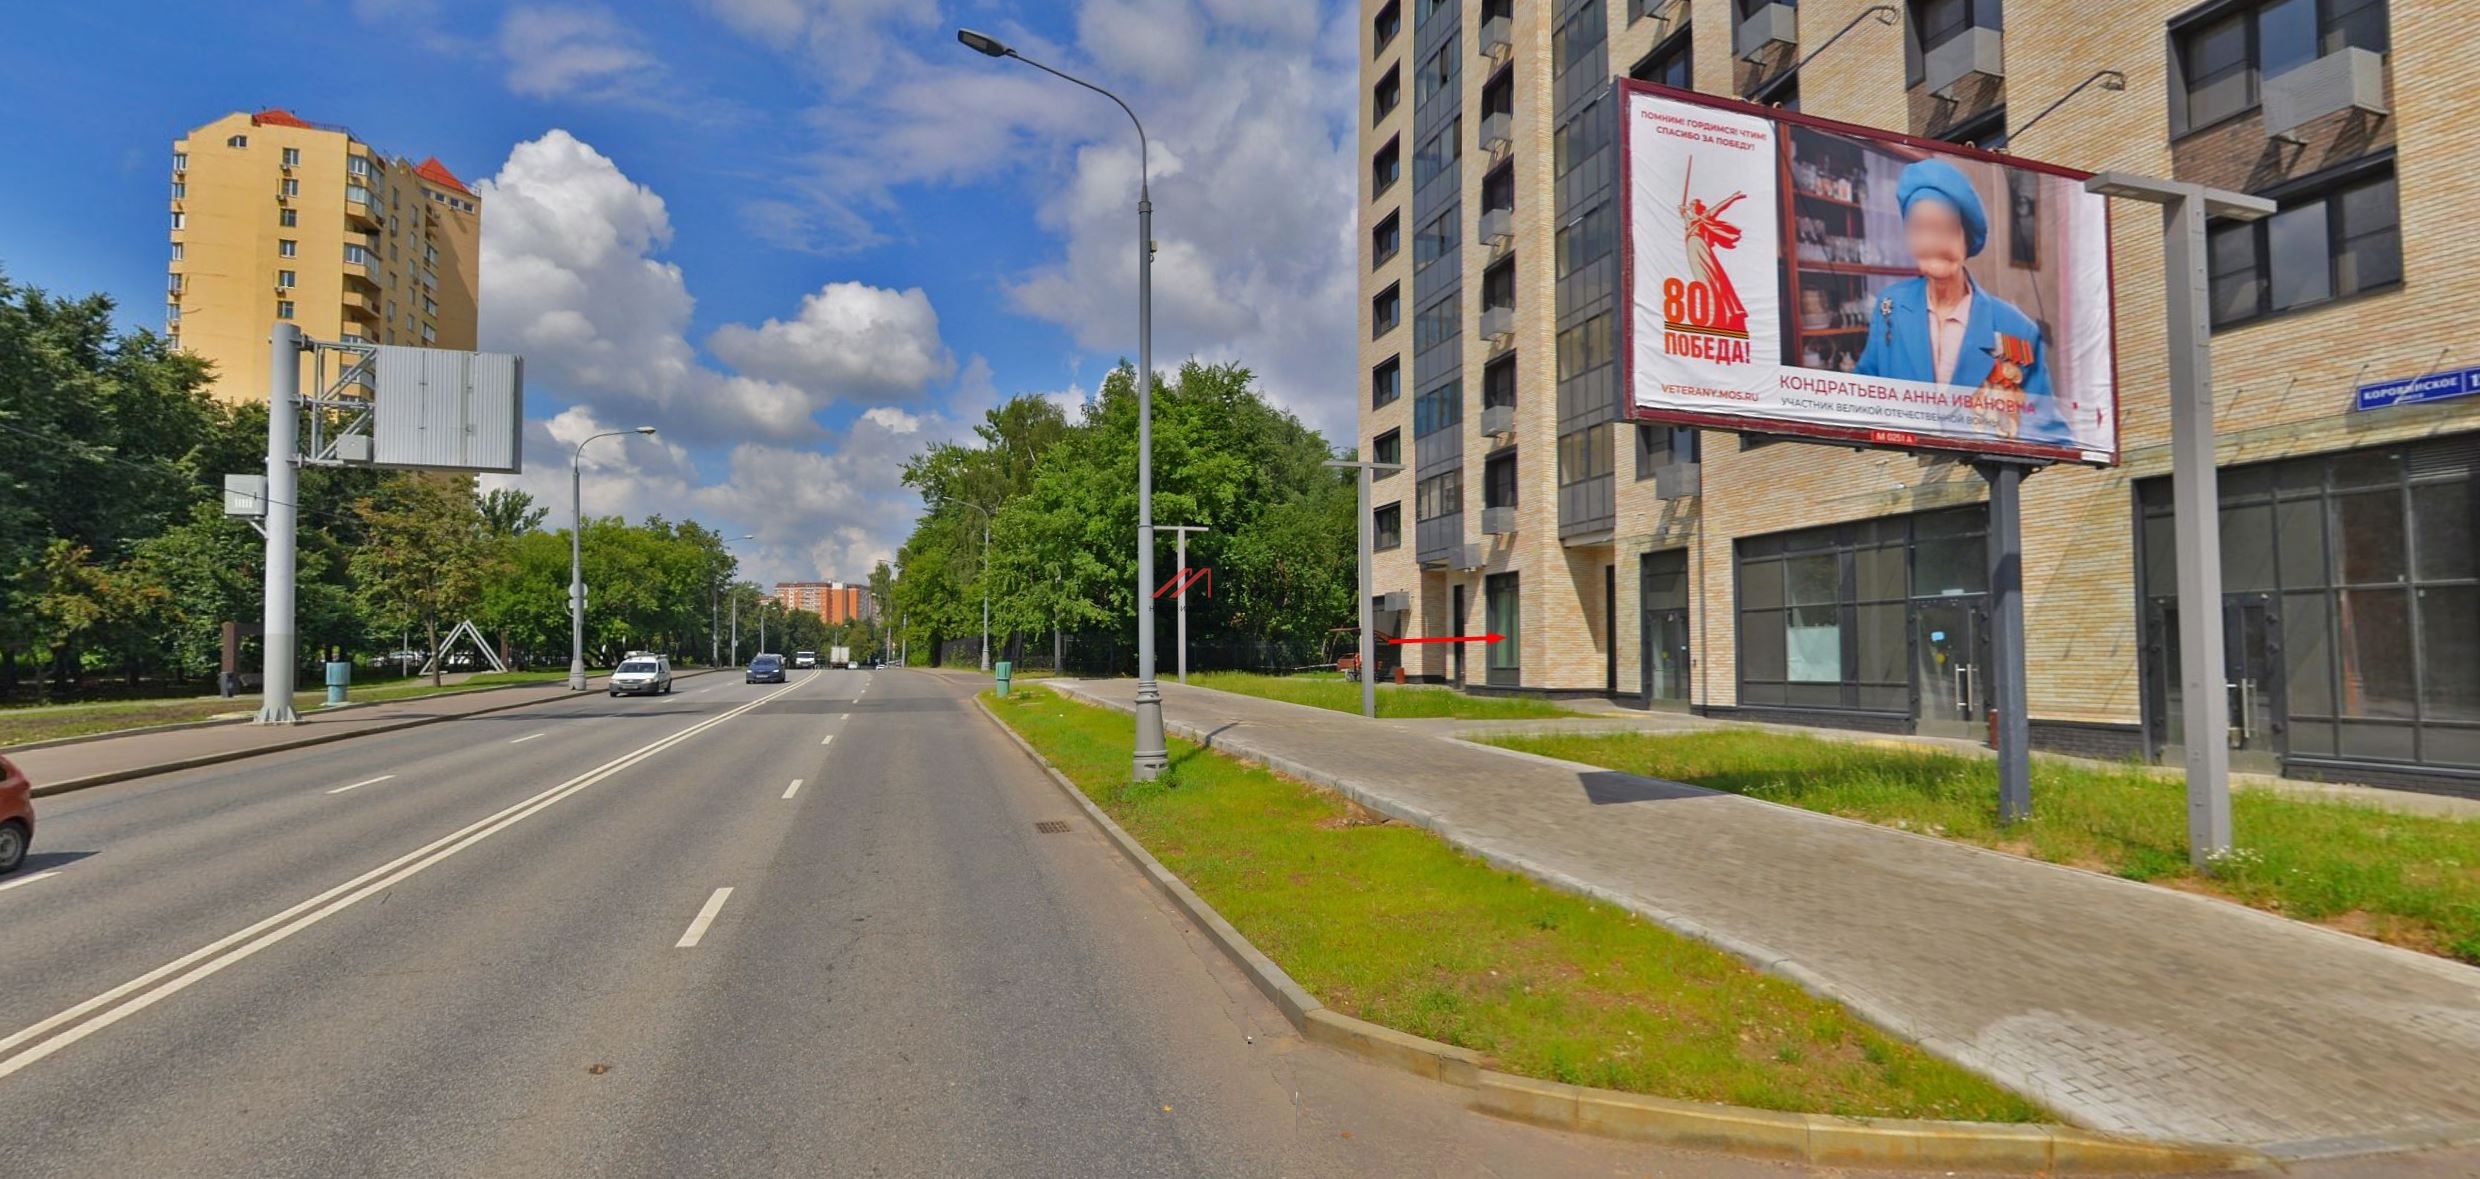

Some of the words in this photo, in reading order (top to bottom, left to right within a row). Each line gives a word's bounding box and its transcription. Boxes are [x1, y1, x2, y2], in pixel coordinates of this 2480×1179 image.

[1656, 125, 1700, 141] СПАСИБО
[1703, 134, 1714, 143] ЗА
[1716, 137, 1755, 151] ПОБЕДУ!
[1687, 119, 1738, 135] ГОРДИМСЯ!
[1663, 277, 1709, 327] 80
[1664, 331, 1751, 366] ПОБЕДА!
[1661, 383, 1760, 402] VETERANY.MOS.RU
[1780, 374, 1899, 402] КОНДРАТЬЕВА
[1902, 389, 1948, 406] АННА
[1952, 393, 2037, 415] ИВАНОВНА
[1781, 397, 1835, 411] УЧАСТНИК
[1836, 402, 1882, 416] ВЕЛИКОЙ
